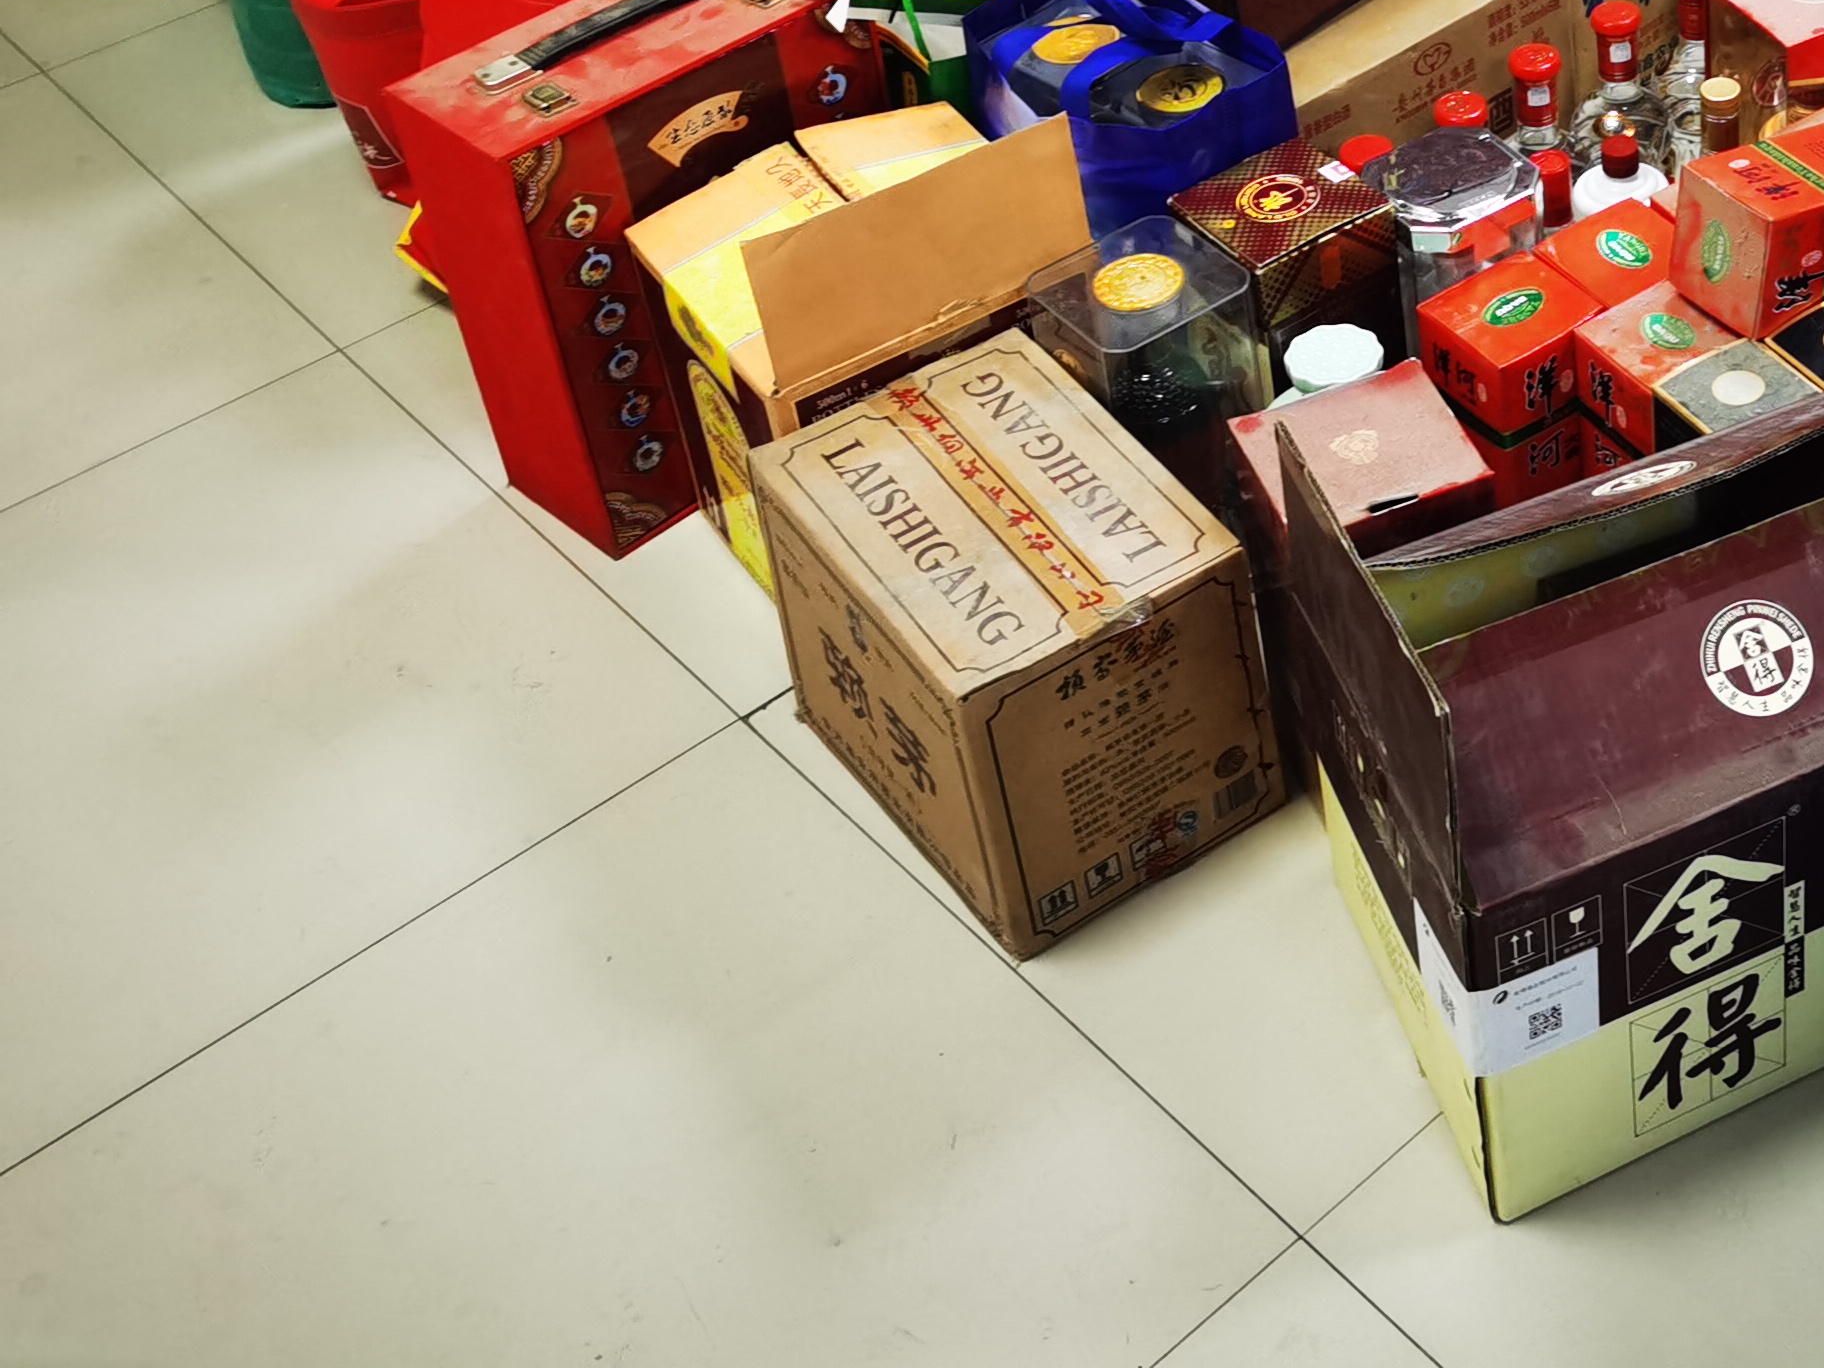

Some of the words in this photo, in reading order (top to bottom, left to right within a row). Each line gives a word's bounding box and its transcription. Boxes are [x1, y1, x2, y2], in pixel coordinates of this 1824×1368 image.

[820, 438, 1026, 646] LAISHIGANG
[960, 372, 1167, 563] LAISHIGANG
[1776, 612, 1803, 640] SHEDE
[1626, 854, 1786, 1110] 舍得
